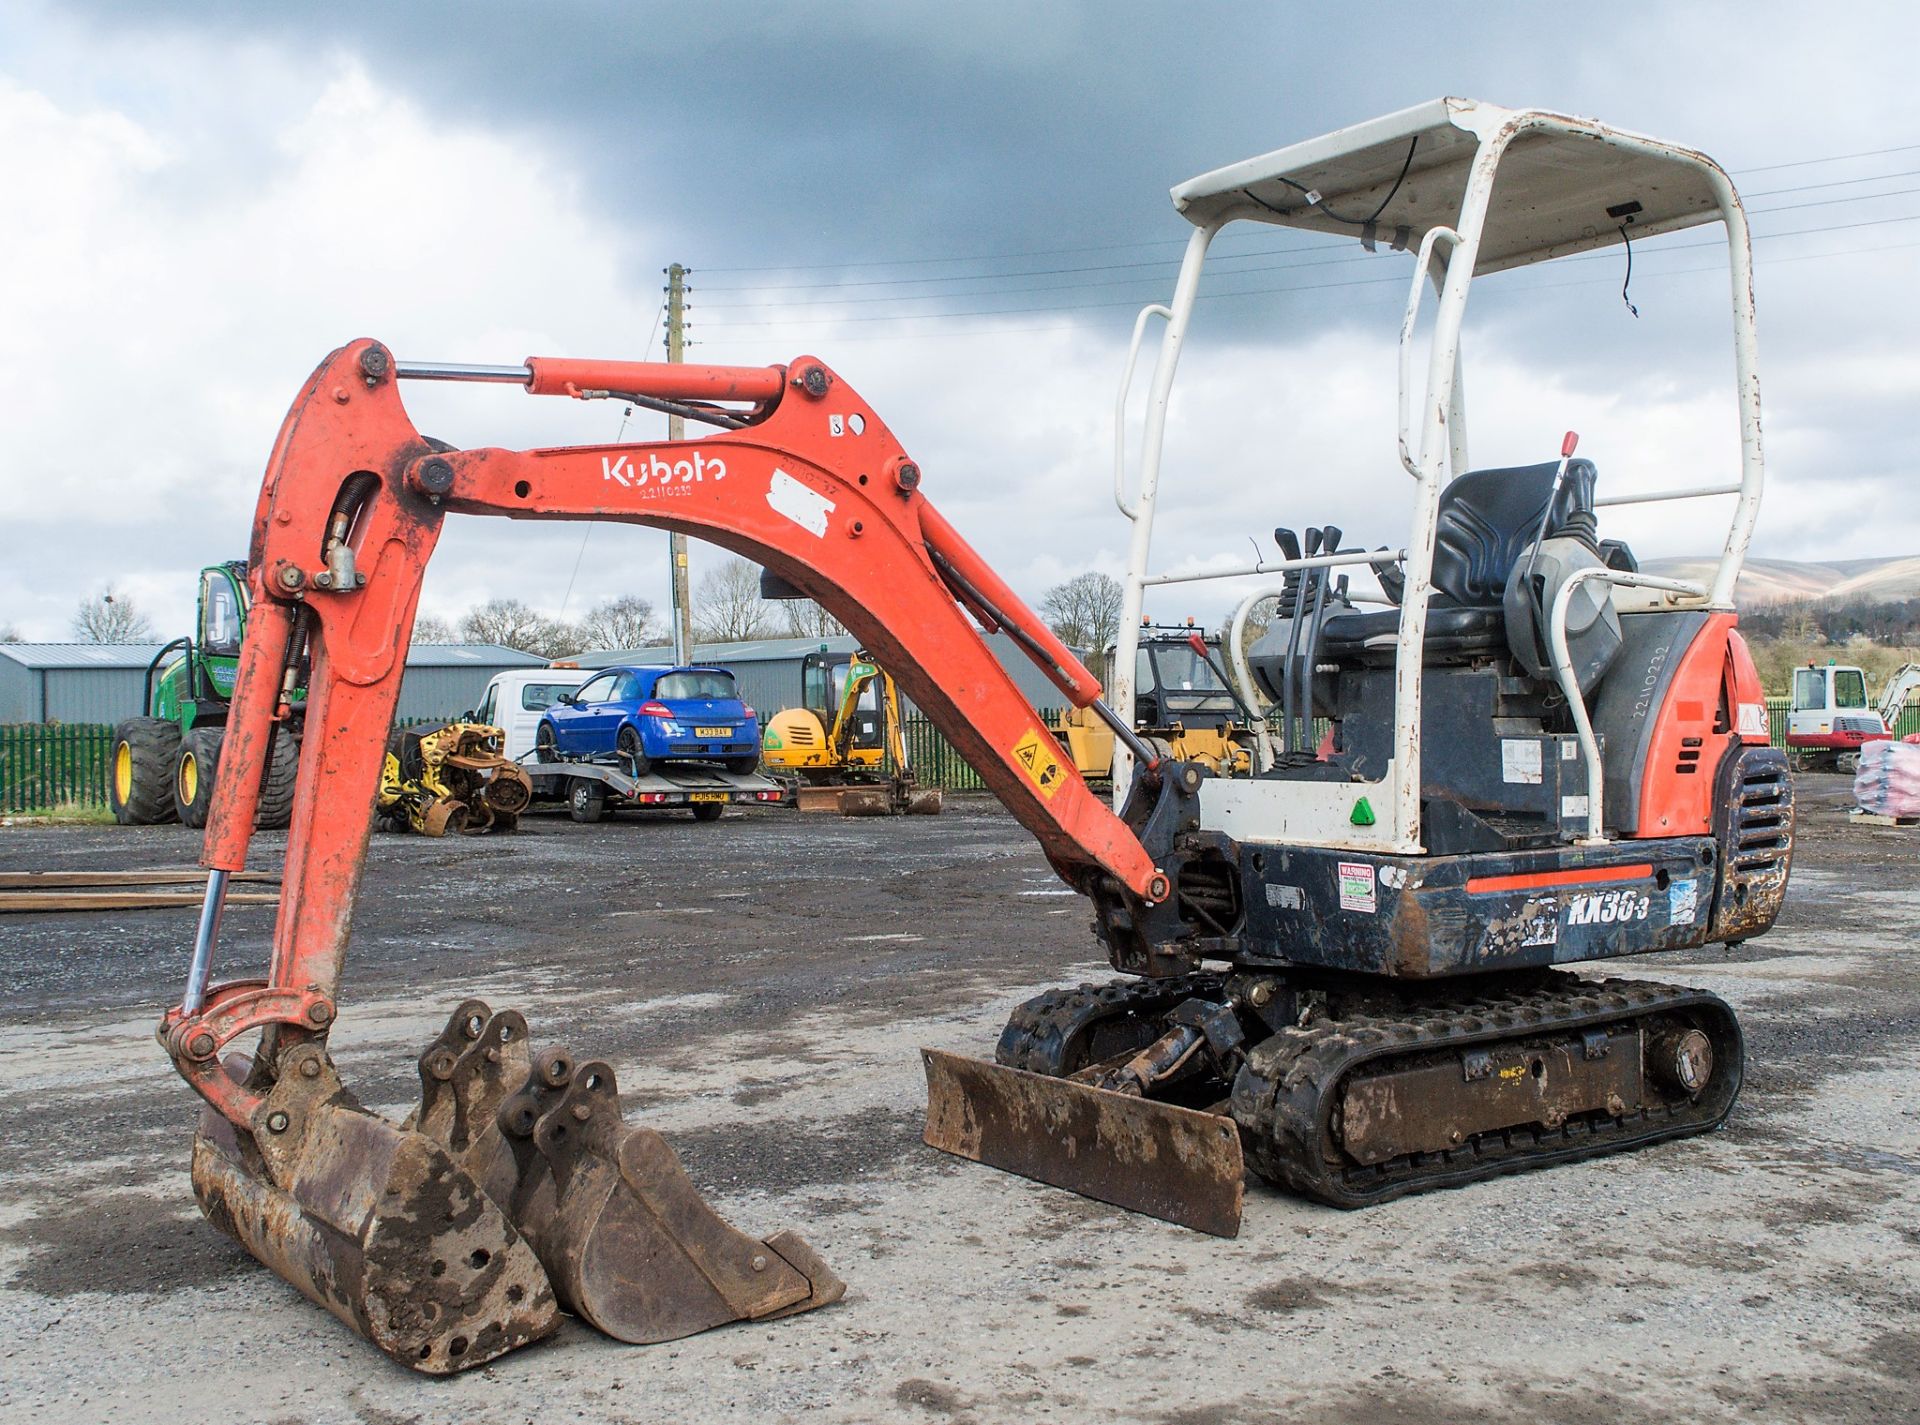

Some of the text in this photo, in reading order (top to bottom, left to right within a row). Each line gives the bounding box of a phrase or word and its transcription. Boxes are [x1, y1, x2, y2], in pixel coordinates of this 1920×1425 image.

[601, 451, 727, 487] Kubota
[640, 484, 693, 500] 22110232
[1632, 645, 1670, 718] 22110232
[1341, 865, 1372, 877] WARNING
